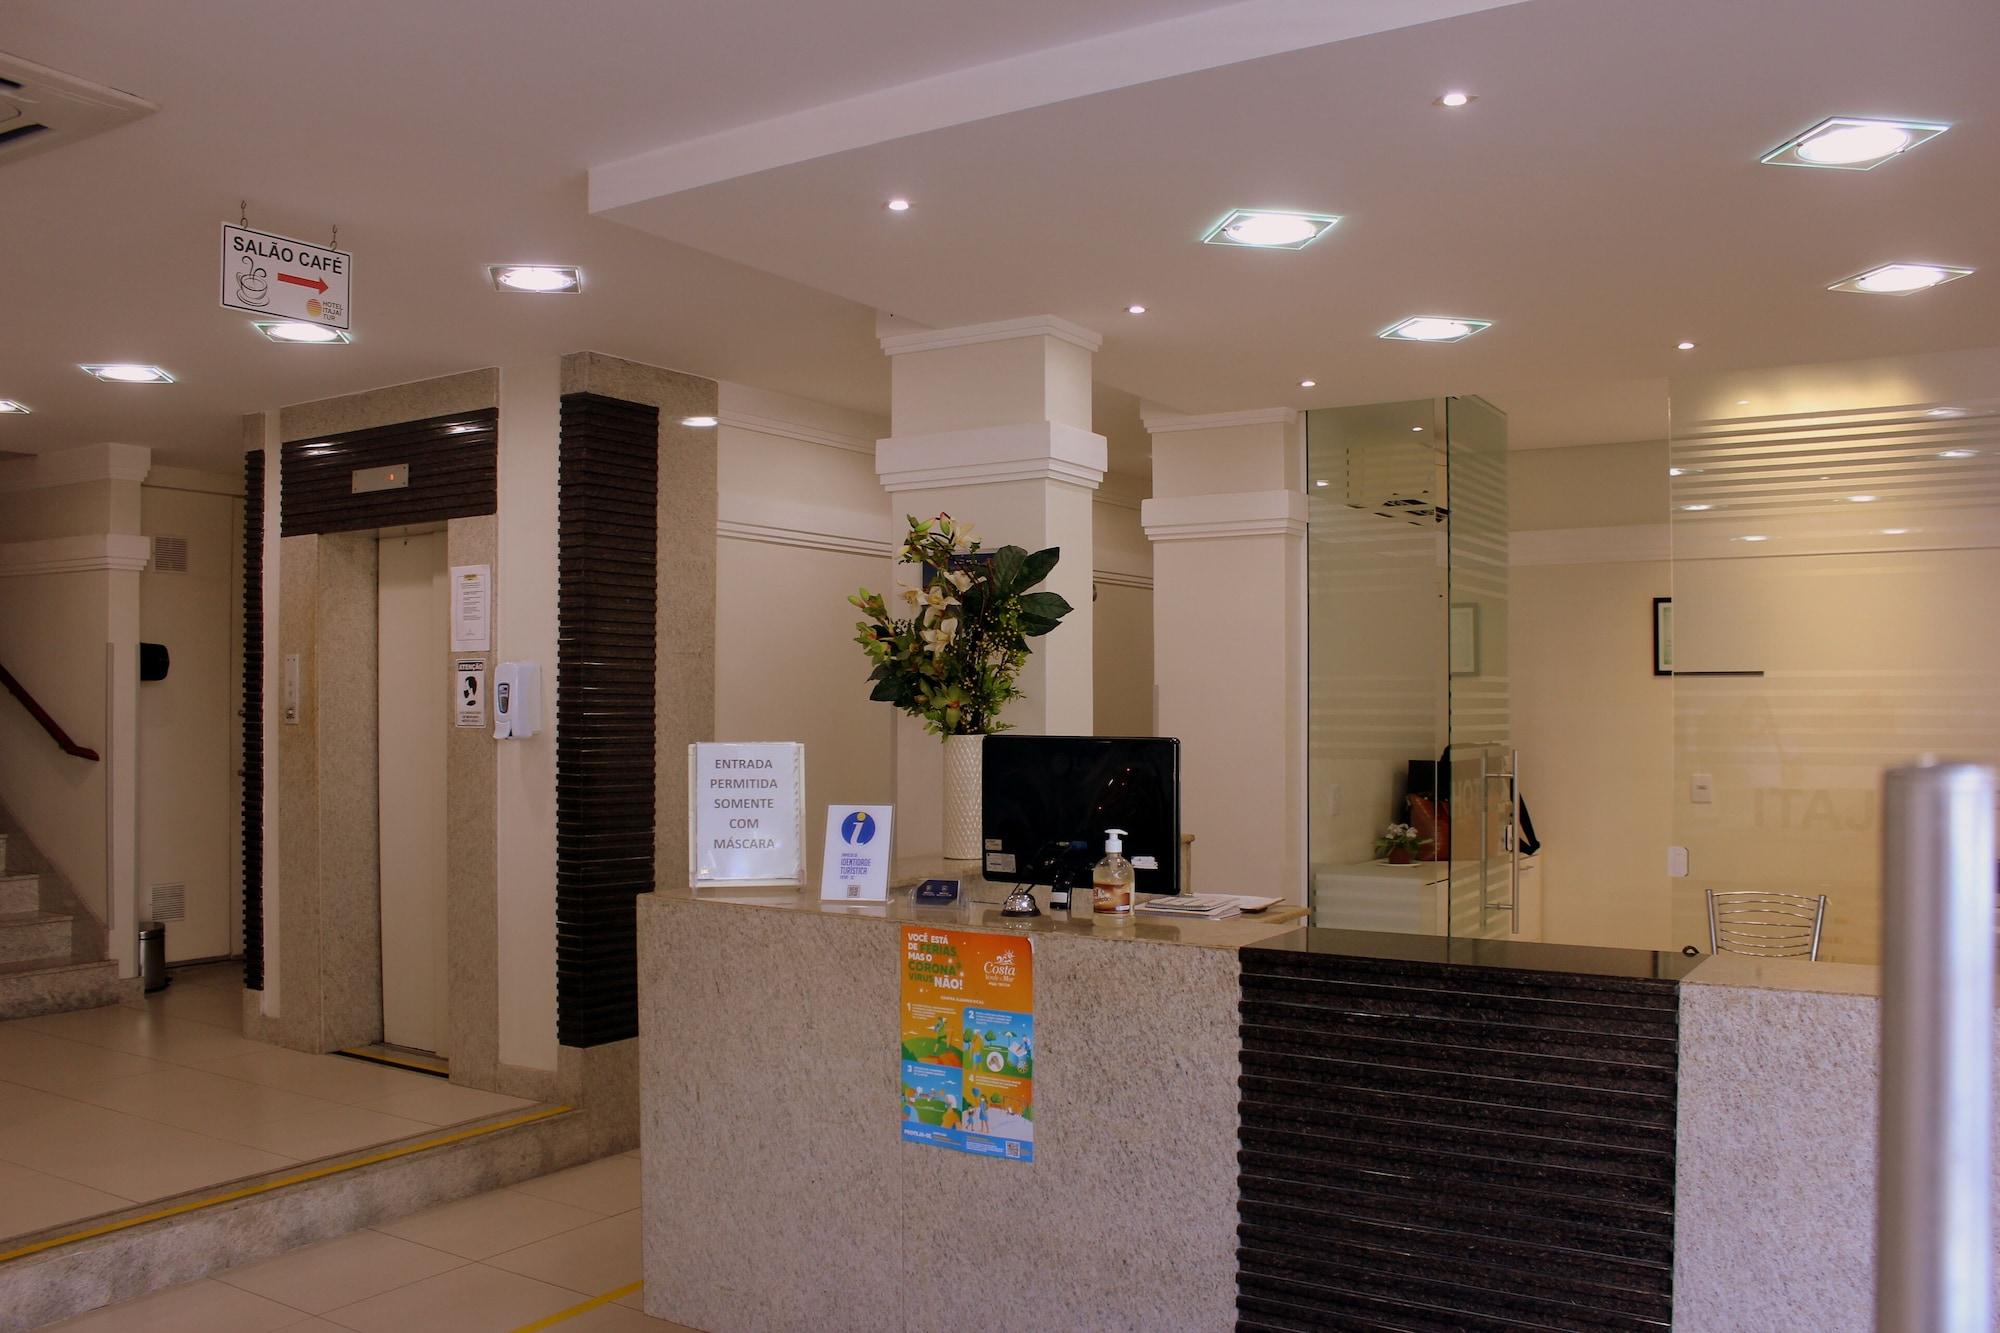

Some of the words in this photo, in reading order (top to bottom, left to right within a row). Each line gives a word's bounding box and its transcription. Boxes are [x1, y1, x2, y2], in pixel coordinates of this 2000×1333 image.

[233, 236, 294, 263] SALÃO
[299, 252, 343, 275] CAFÉ
[322, 300, 343, 310] HOTEL
[459, 662, 483, 670] ATENÇÃO
[715, 759, 773, 769] ENTRADA
[710, 779, 778, 789] PERMITIDA
[714, 798, 774, 809] SOMENTE
[729, 819, 759, 829] COM
[713, 836, 775, 849] MÁSCARA
[907, 932, 929, 943] VOCÊ
[930, 934, 949, 945] ESTÁ
[907, 942, 918, 951] DE
[907, 951, 925, 961] MAS
[925, 953, 933, 962] O
[908, 960, 957, 976] CORONA
[983, 961, 1016, 976] Costa
[934, 974, 963, 990] NÃO!
[968, 1010, 975, 1019] 2
